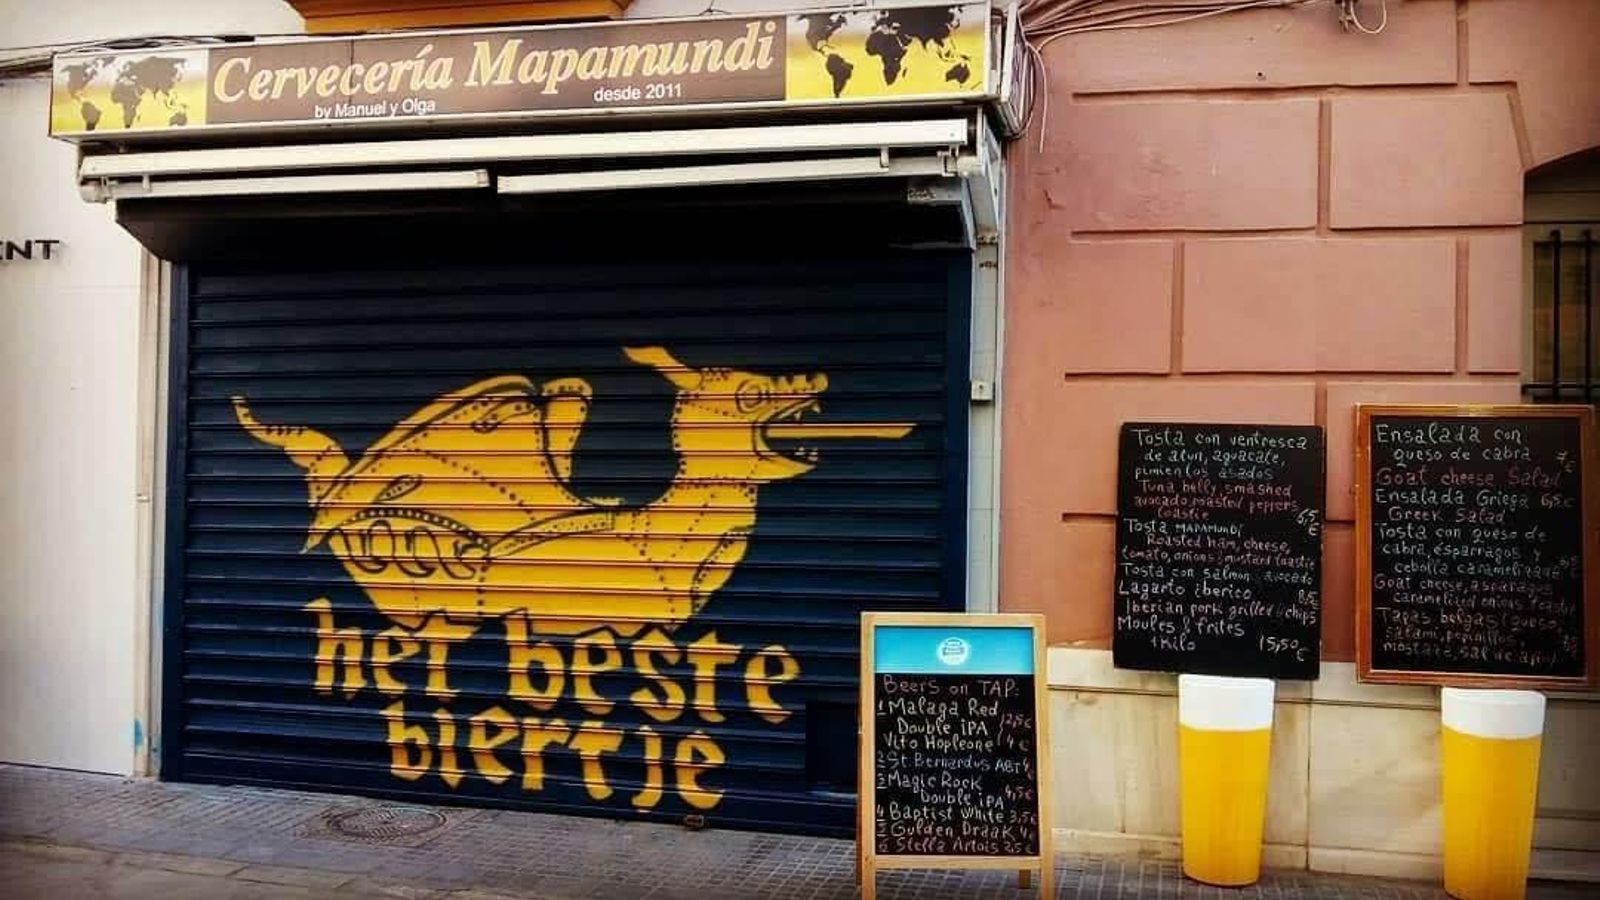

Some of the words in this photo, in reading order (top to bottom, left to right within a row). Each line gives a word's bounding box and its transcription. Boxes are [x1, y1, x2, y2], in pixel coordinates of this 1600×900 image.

[213, 44, 454, 104] Cervecería
[464, 20, 777, 95] Mapamundi
[593, 86, 641, 102] desde
[645, 83, 682, 99] 2011
[314, 105, 331, 118] by
[334, 103, 387, 117] Manuel
[390, 105, 398, 117] y
[402, 98, 436, 115] Olga
[0, 239, 60, 260] NT
[1131, 428, 1185, 447] Tosta
[1195, 433, 1220, 445] con
[1230, 430, 1307, 449] ventresca
[1375, 422, 1481, 444] Ensalada
[1494, 427, 1522, 444] con
[1144, 450, 1162, 462] de
[1393, 447, 1442, 468] queso
[1450, 446, 1471, 461] de
[1482, 445, 1531, 461] cabra
[1376, 465, 1427, 486] Goat
[1440, 468, 1495, 486] cheese
[1507, 467, 1561, 487] Salad
[1137, 479, 1175, 494] Tuna
[1225, 482, 1292, 497] smashed
[1375, 487, 1464, 505] Ensalada
[1476, 489, 1530, 512] Griega
[1388, 506, 1443, 522] Greek
[1455, 507, 1506, 524] Salad
[1123, 518, 1168, 535] Tosta
[1375, 522, 1427, 540] Tosta
[1435, 526, 1462, 539] con
[1472, 526, 1518, 544] queso
[1525, 526, 1550, 541] de
[1147, 533, 1201, 548] Roasted
[1243, 536, 1291, 555] cheese,
[1120, 562, 1164, 577] Tosta
[1172, 568, 1195, 578] con
[1203, 565, 1250, 582] salmon
[1394, 558, 1448, 576] cebolla
[1119, 581, 1186, 600] Lagarto
[1195, 581, 1253, 600] iberico
[1374, 573, 1411, 590] Goat
[1126, 599, 1183, 616] Iberian
[1190, 601, 1223, 617] pork
[1285, 605, 1317, 626] chips
[1118, 615, 1176, 634] Moules
[1197, 618, 1245, 637] frites
[304, 596, 482, 700] het
[503, 606, 802, 724] beste
[883, 674, 940, 694] Beers
[949, 684, 968, 695] on
[888, 696, 959, 721] Malaga
[968, 697, 999, 716] Red
[897, 715, 951, 736] Double
[925, 734, 994, 754] Hopleone
[379, 700, 728, 812] biertje
[887, 750, 908, 769] St
[914, 751, 990, 771] Bernardus
[887, 769, 937, 794] Magic
[941, 770, 983, 791] Rock
[921, 787, 971, 806] Double
[889, 801, 953, 821] Baptist
[960, 804, 1004, 824] White
[890, 818, 954, 839] Gulden
[896, 836, 946, 853] Stella
[953, 836, 999, 855] Artois
